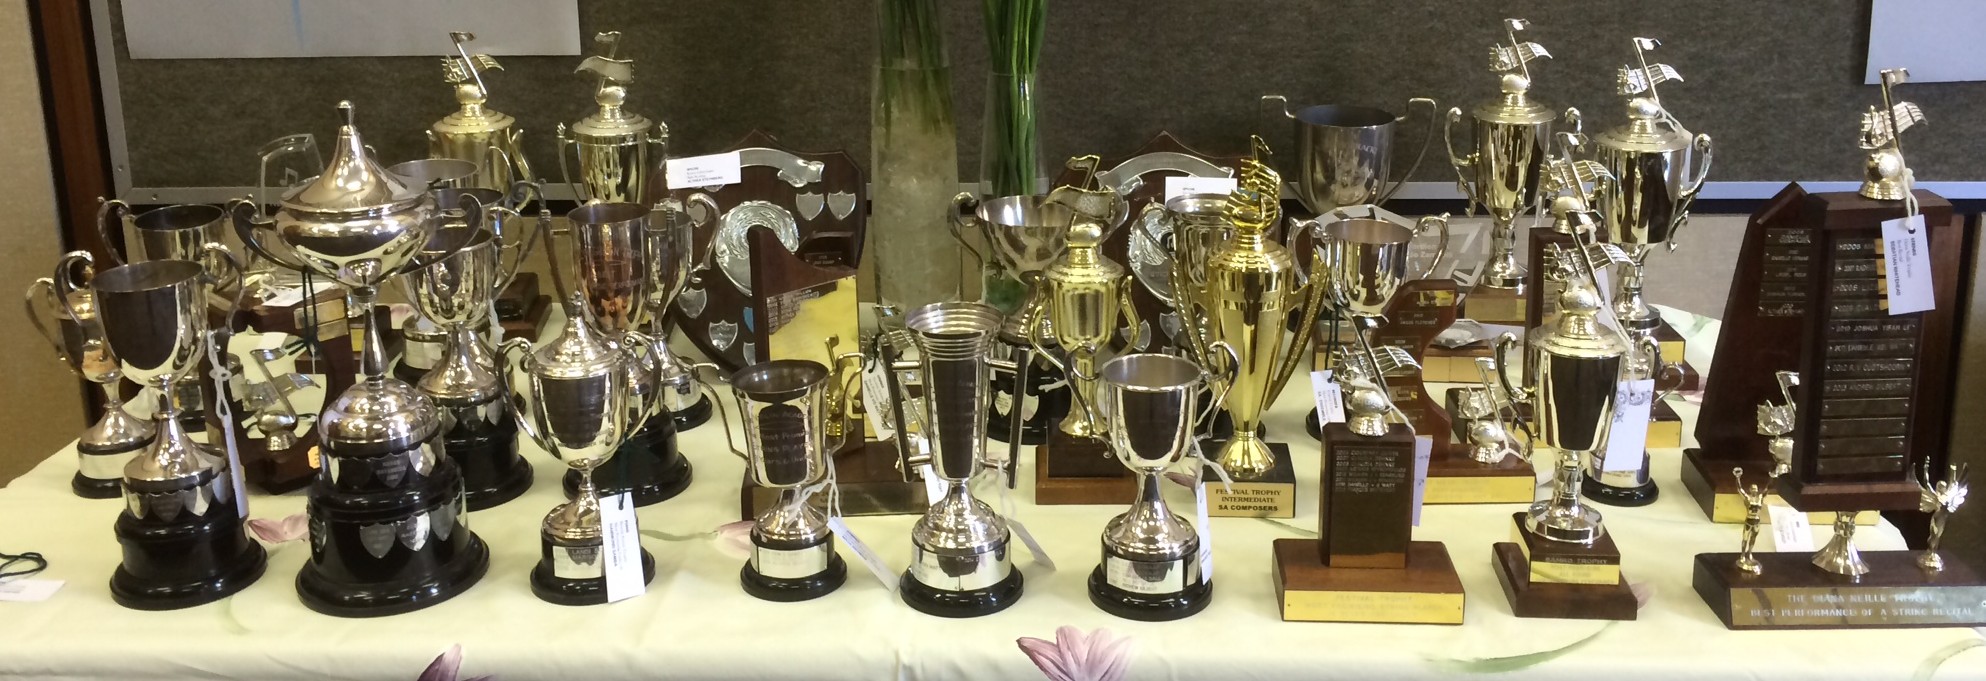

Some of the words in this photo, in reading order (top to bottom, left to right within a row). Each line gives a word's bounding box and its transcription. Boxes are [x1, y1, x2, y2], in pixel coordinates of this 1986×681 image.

[1787, 594, 1805, 603] THE
[1750, 608, 1776, 617] BEST
[1780, 607, 1858, 617] PERFORMANCE
[1861, 607, 1874, 617] OF
[1880, 607, 1888, 616] A
[1932, 607, 1974, 616] RECITAL
